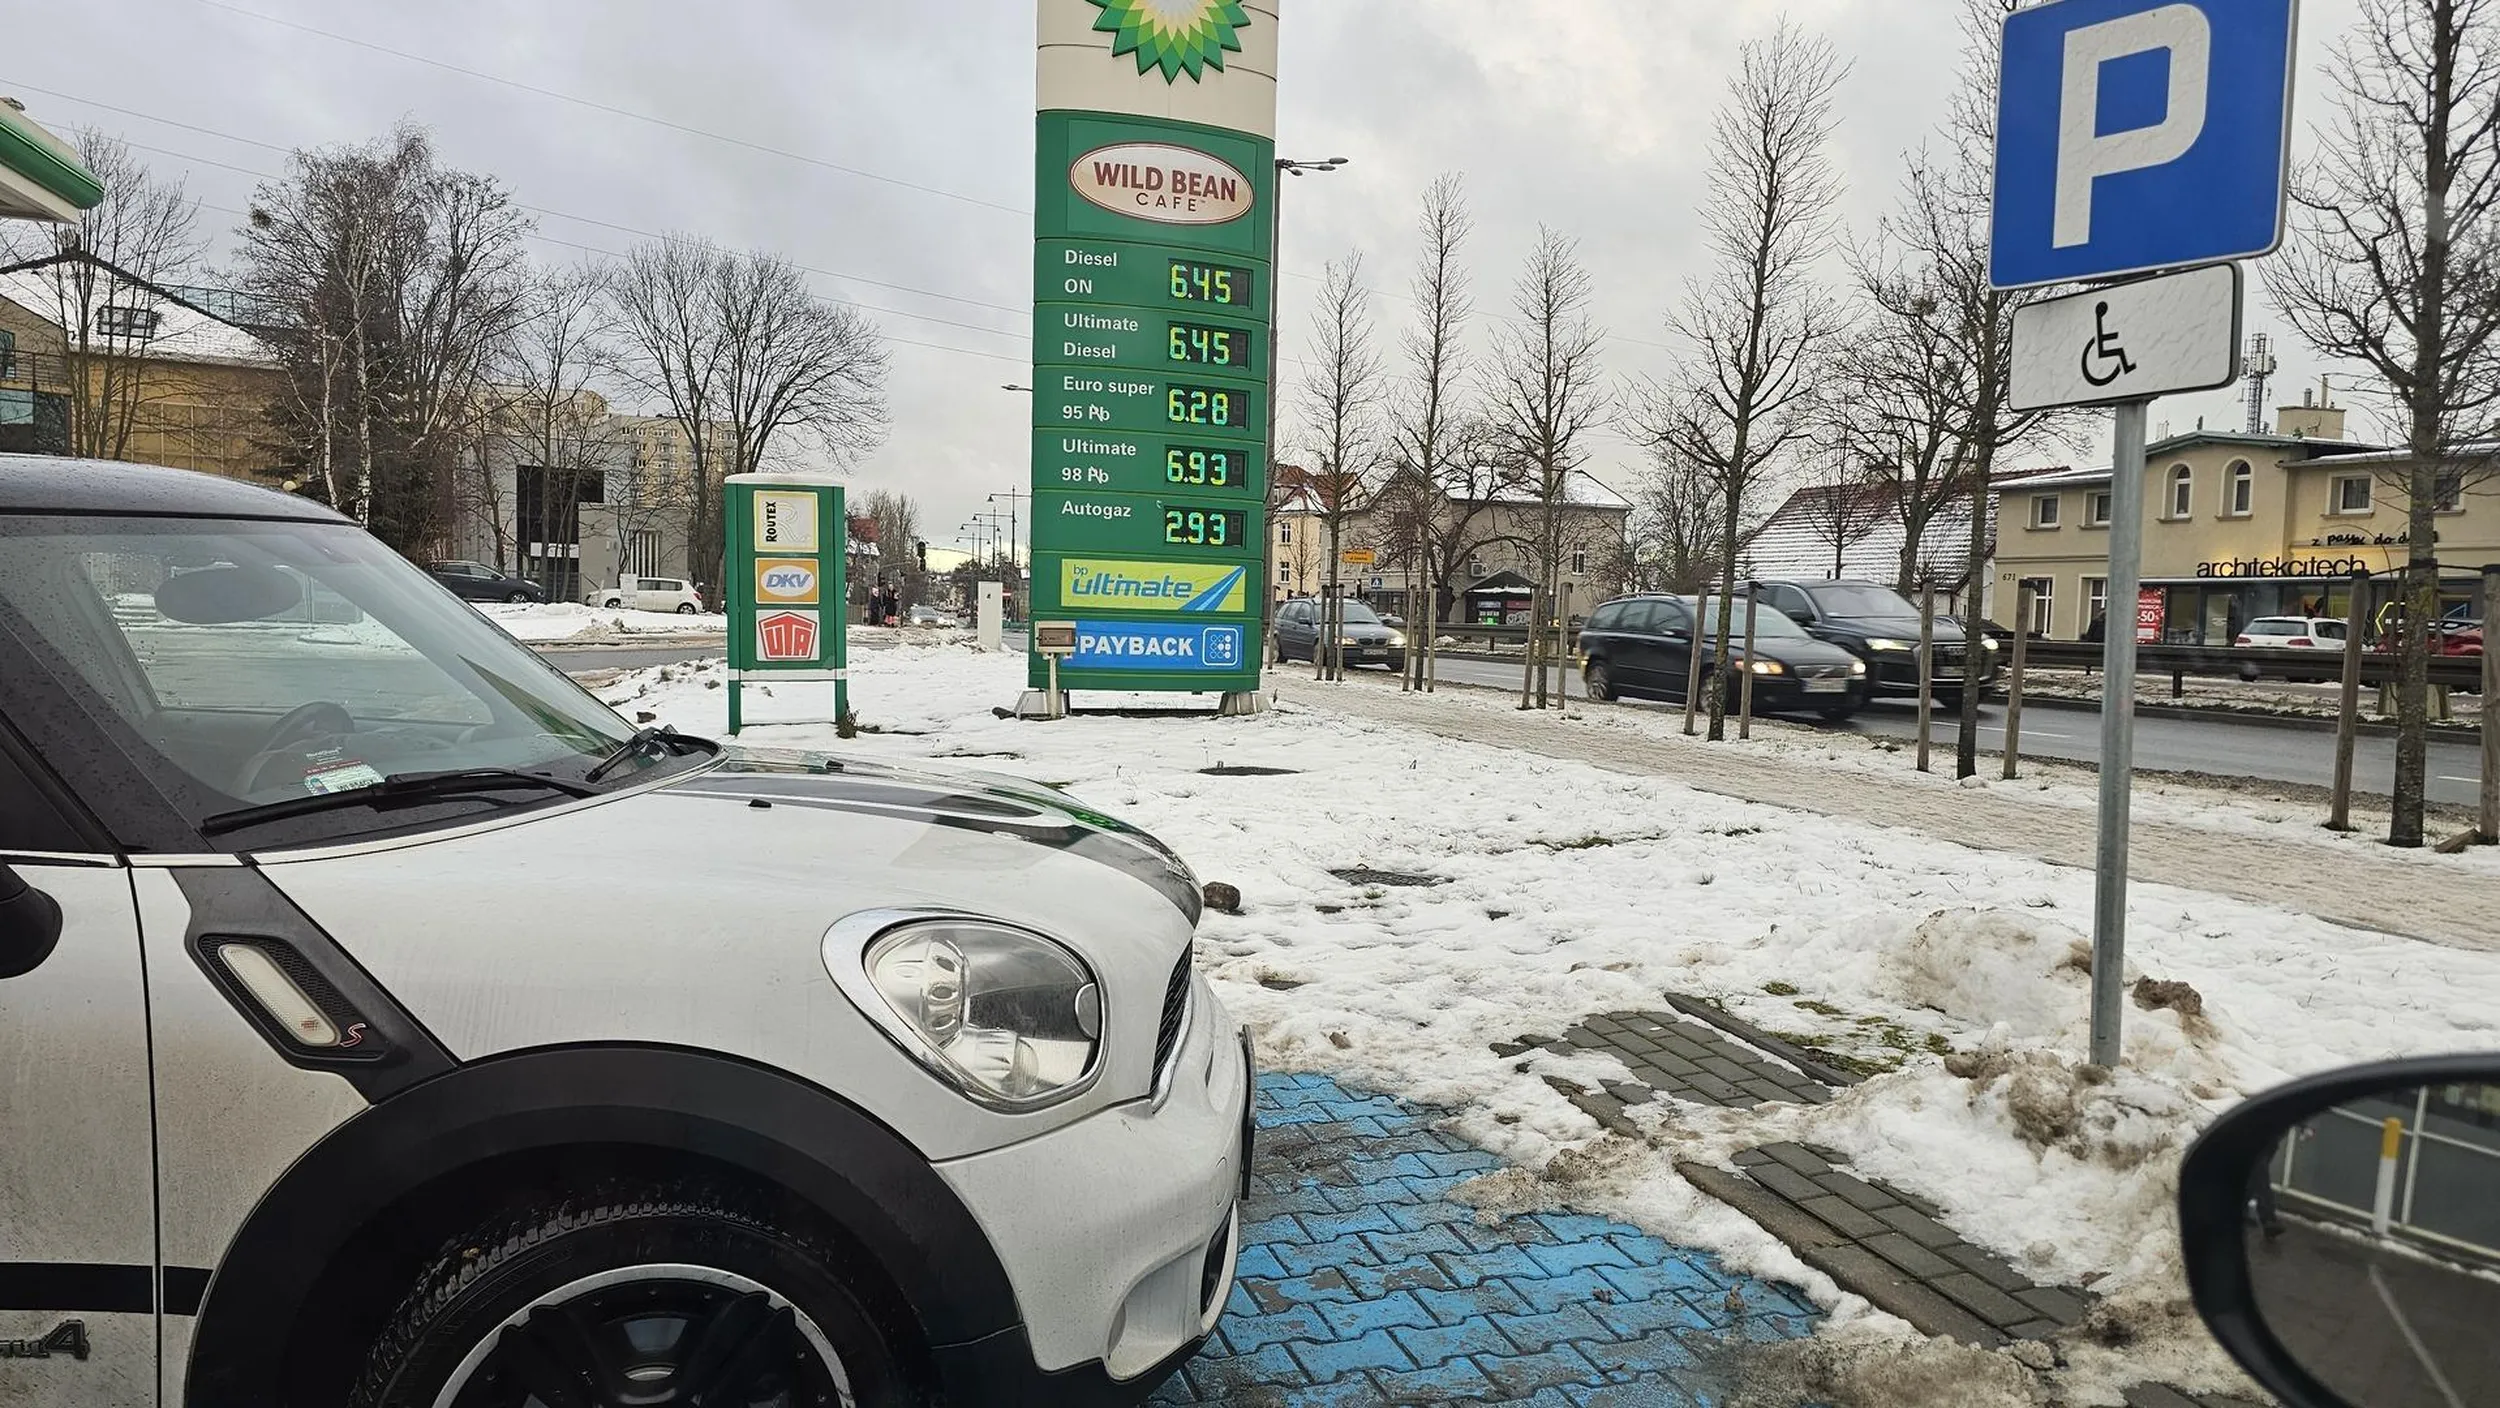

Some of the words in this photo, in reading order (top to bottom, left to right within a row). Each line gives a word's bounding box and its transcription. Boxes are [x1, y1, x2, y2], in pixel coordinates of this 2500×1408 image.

[2053, 3, 2211, 249] P
[1093, 162, 1164, 191] WILD
[1172, 169, 1236, 202] BEAN
[1065, 249, 1117, 267] Diesel
[1064, 278, 1092, 294] ON
[1170, 263, 1232, 304] 6.45
[1064, 312, 1139, 332] Ultimate
[1063, 341, 1116, 359] Diesel
[1169, 326, 1230, 365] 6.45
[1063, 376, 1103, 392] Euro
[1108, 381, 1155, 397] super
[1062, 405, 1082, 419] 95
[1168, 388, 1229, 425] 6.28
[1062, 438, 1137, 456] Ultimate
[1061, 467, 1082, 481] 98
[1167, 450, 1227, 486] 6.93
[1061, 500, 1132, 519] Autogaz
[766, 501, 777, 542] ROUTEX
[1166, 510, 1226, 545] 2.93
[766, 573, 811, 588] DKV
[1073, 564, 1088, 577] bp
[1071, 573, 1193, 598] ultimate
[763, 615, 813, 657] UTA
[1080, 635, 1194, 657] PAYBACK
